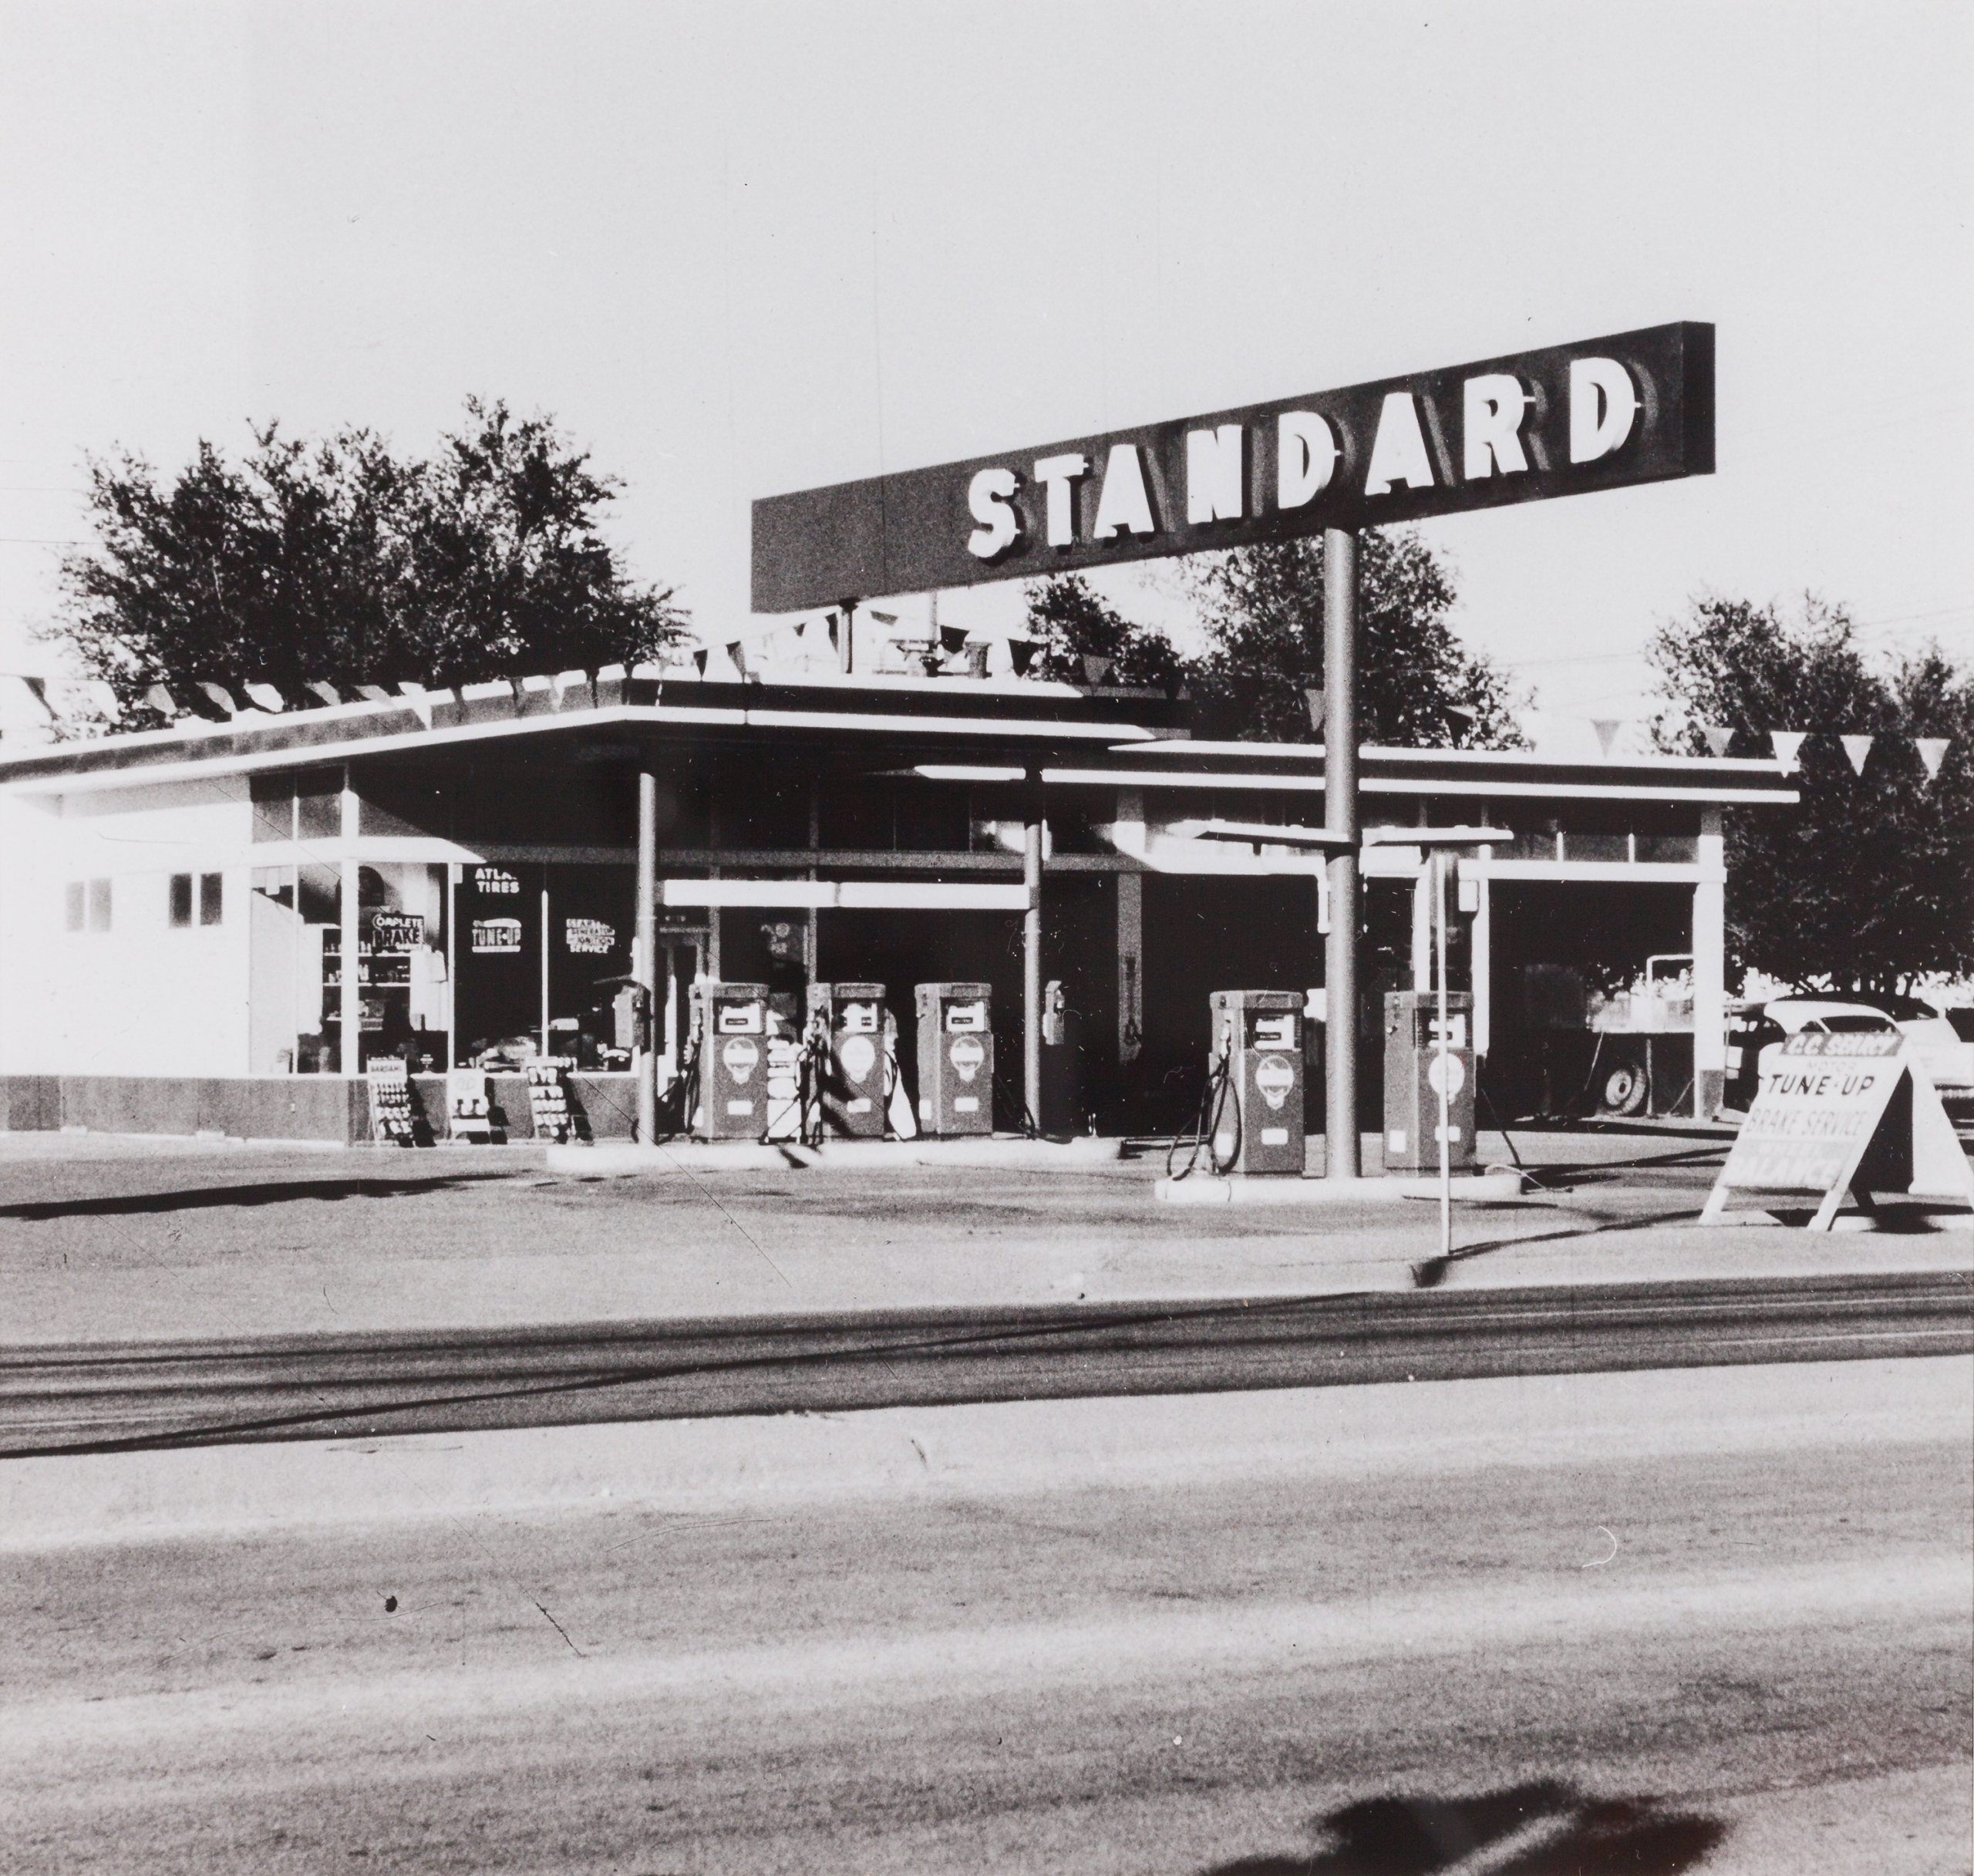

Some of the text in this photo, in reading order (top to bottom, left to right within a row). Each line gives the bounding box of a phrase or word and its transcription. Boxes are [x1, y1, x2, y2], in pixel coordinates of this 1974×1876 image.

[966, 357, 1638, 560] STANDARD
[475, 867, 517, 881] ATLA
[477, 881, 520, 893] TIRES
[373, 928, 420, 948] BRAKE
[570, 945, 608, 954] SERVICE
[1746, 1109, 1868, 1137] BRAKE SERVICE
